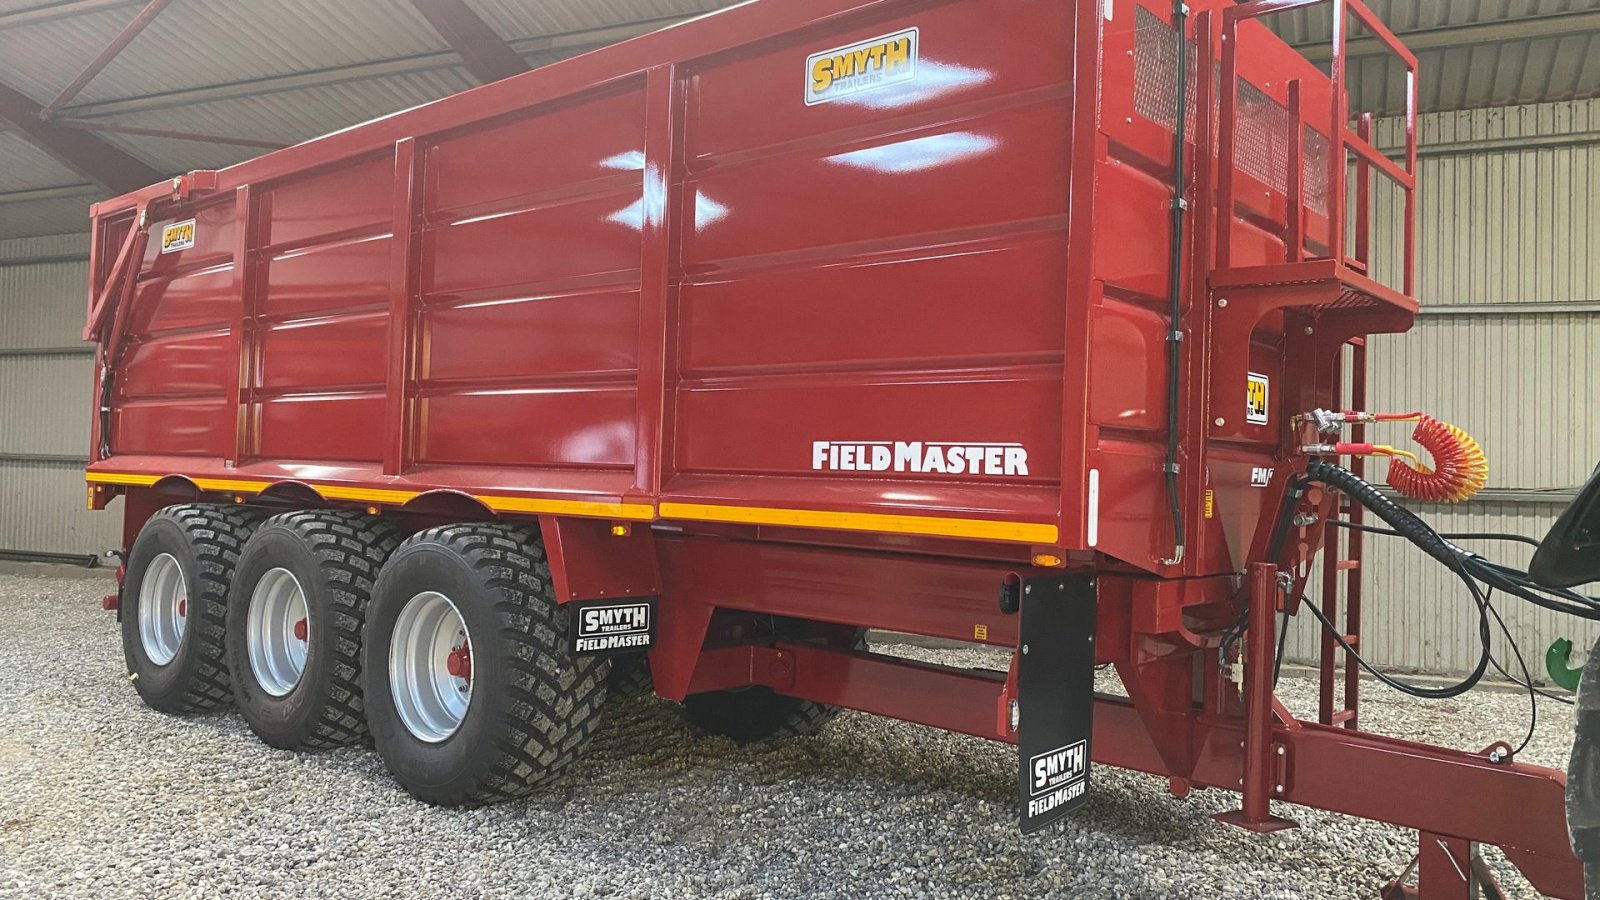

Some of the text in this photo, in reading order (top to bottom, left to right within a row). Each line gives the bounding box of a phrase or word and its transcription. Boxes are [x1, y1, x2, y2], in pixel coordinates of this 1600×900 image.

[812, 38, 911, 94] SMYTH
[834, 73, 882, 92] TRAILERS
[164, 224, 193, 248] SMYTH
[585, 607, 646, 631] SMYTH
[601, 624, 632, 632] TRAILERS
[1035, 744, 1084, 788] SMYTH
[1048, 770, 1073, 786] TRAILERS
